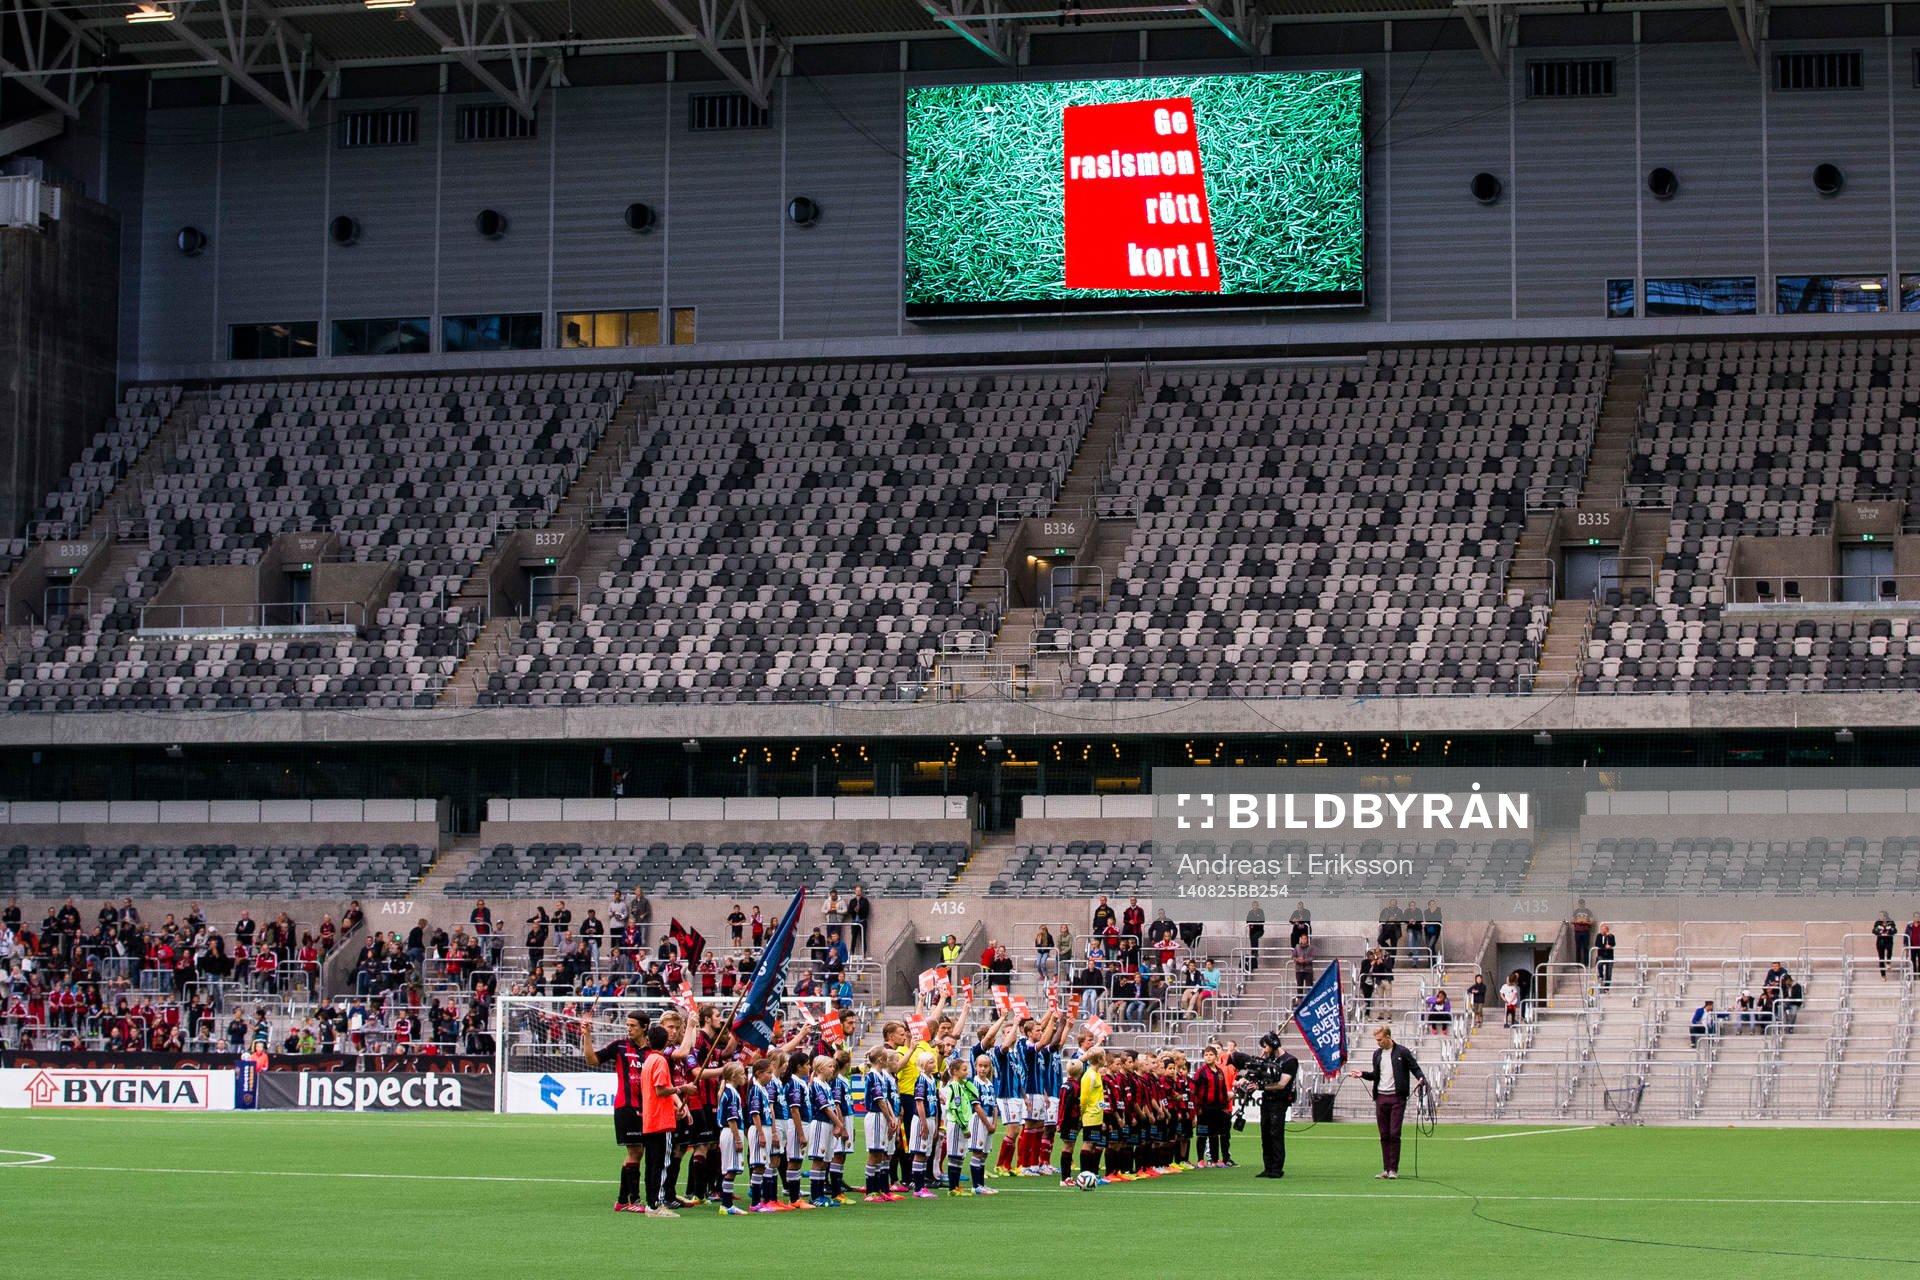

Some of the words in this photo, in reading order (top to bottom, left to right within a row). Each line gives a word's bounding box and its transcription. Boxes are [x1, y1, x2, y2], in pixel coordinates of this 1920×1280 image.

[1154, 108, 1189, 135] Ge
[1070, 149, 1195, 180] rasismen
[1146, 192, 1203, 224] rött
[1128, 242, 1193, 278] kort
[1578, 512, 1610, 526] B335
[1044, 522, 1075, 535] B336
[535, 533, 565, 546] B337
[60, 545, 89, 557] B338
[381, 901, 414, 915] A137
[931, 901, 966, 916] A136
[1513, 899, 1549, 914] A135
[64, 1079, 199, 1104] BYGMA
[298, 1072, 462, 1112] Inspecta
